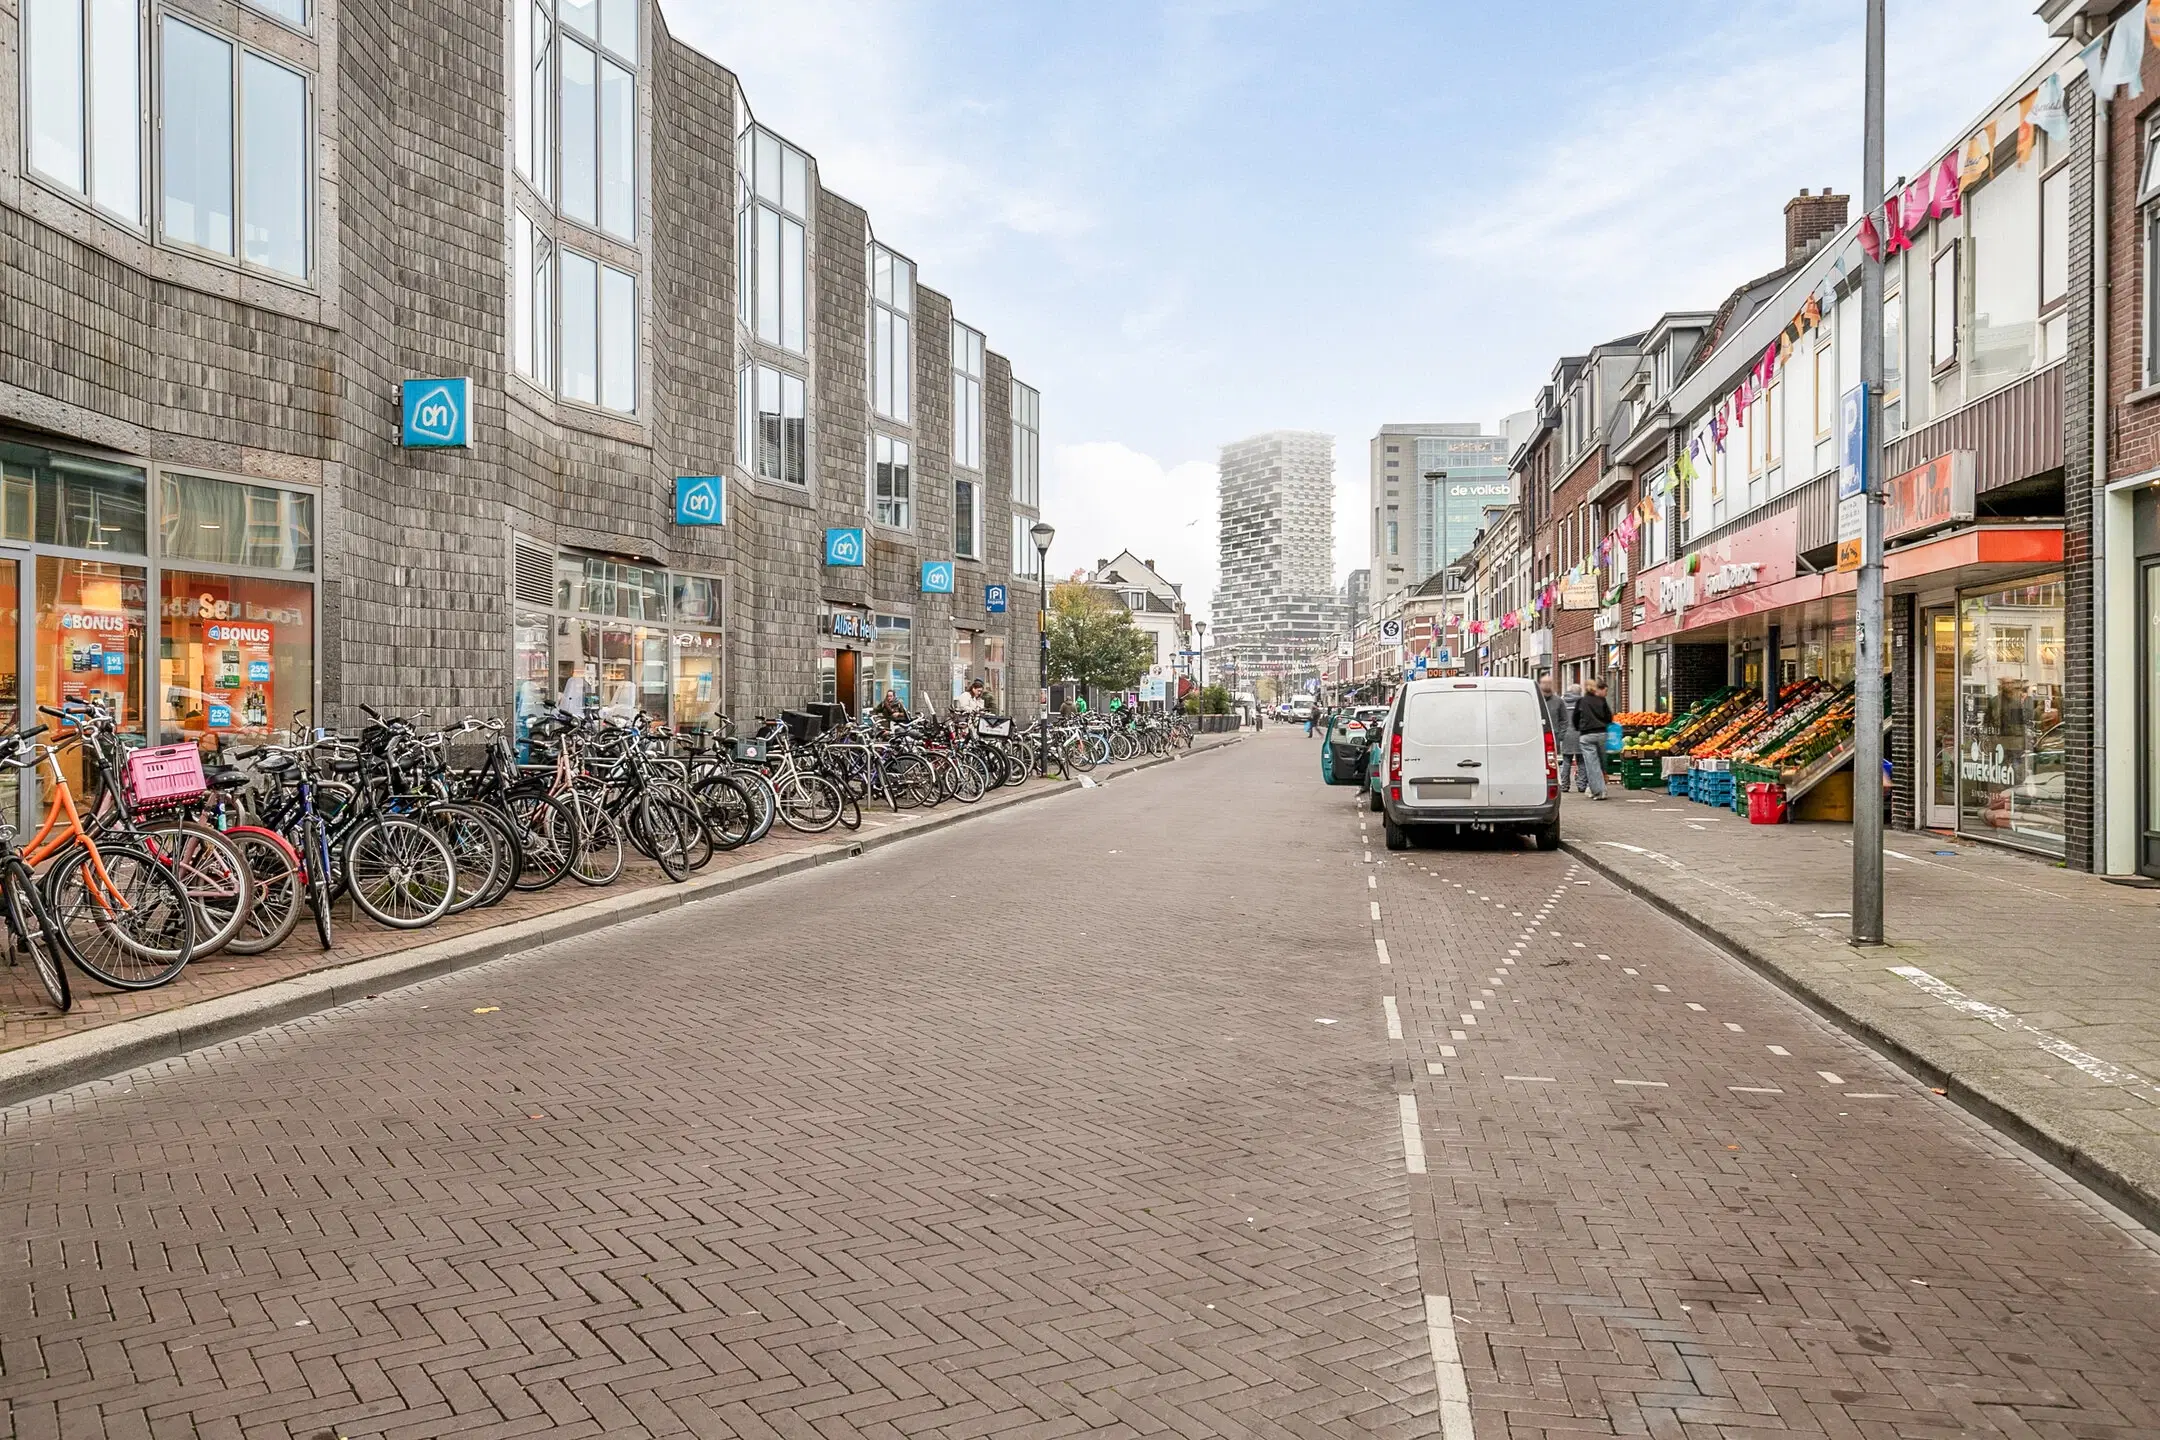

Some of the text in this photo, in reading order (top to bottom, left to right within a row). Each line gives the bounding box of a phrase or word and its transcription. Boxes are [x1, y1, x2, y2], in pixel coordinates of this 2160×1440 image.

[1451, 485, 1468, 496] de
[72, 615, 124, 631] BONUS
[834, 614, 878, 643] Albert Heijn
[221, 627, 270, 642] BONUS
[107, 656, 122, 665] 1+1
[250, 665, 268, 673] 25%
[211, 709, 230, 717] 25%
